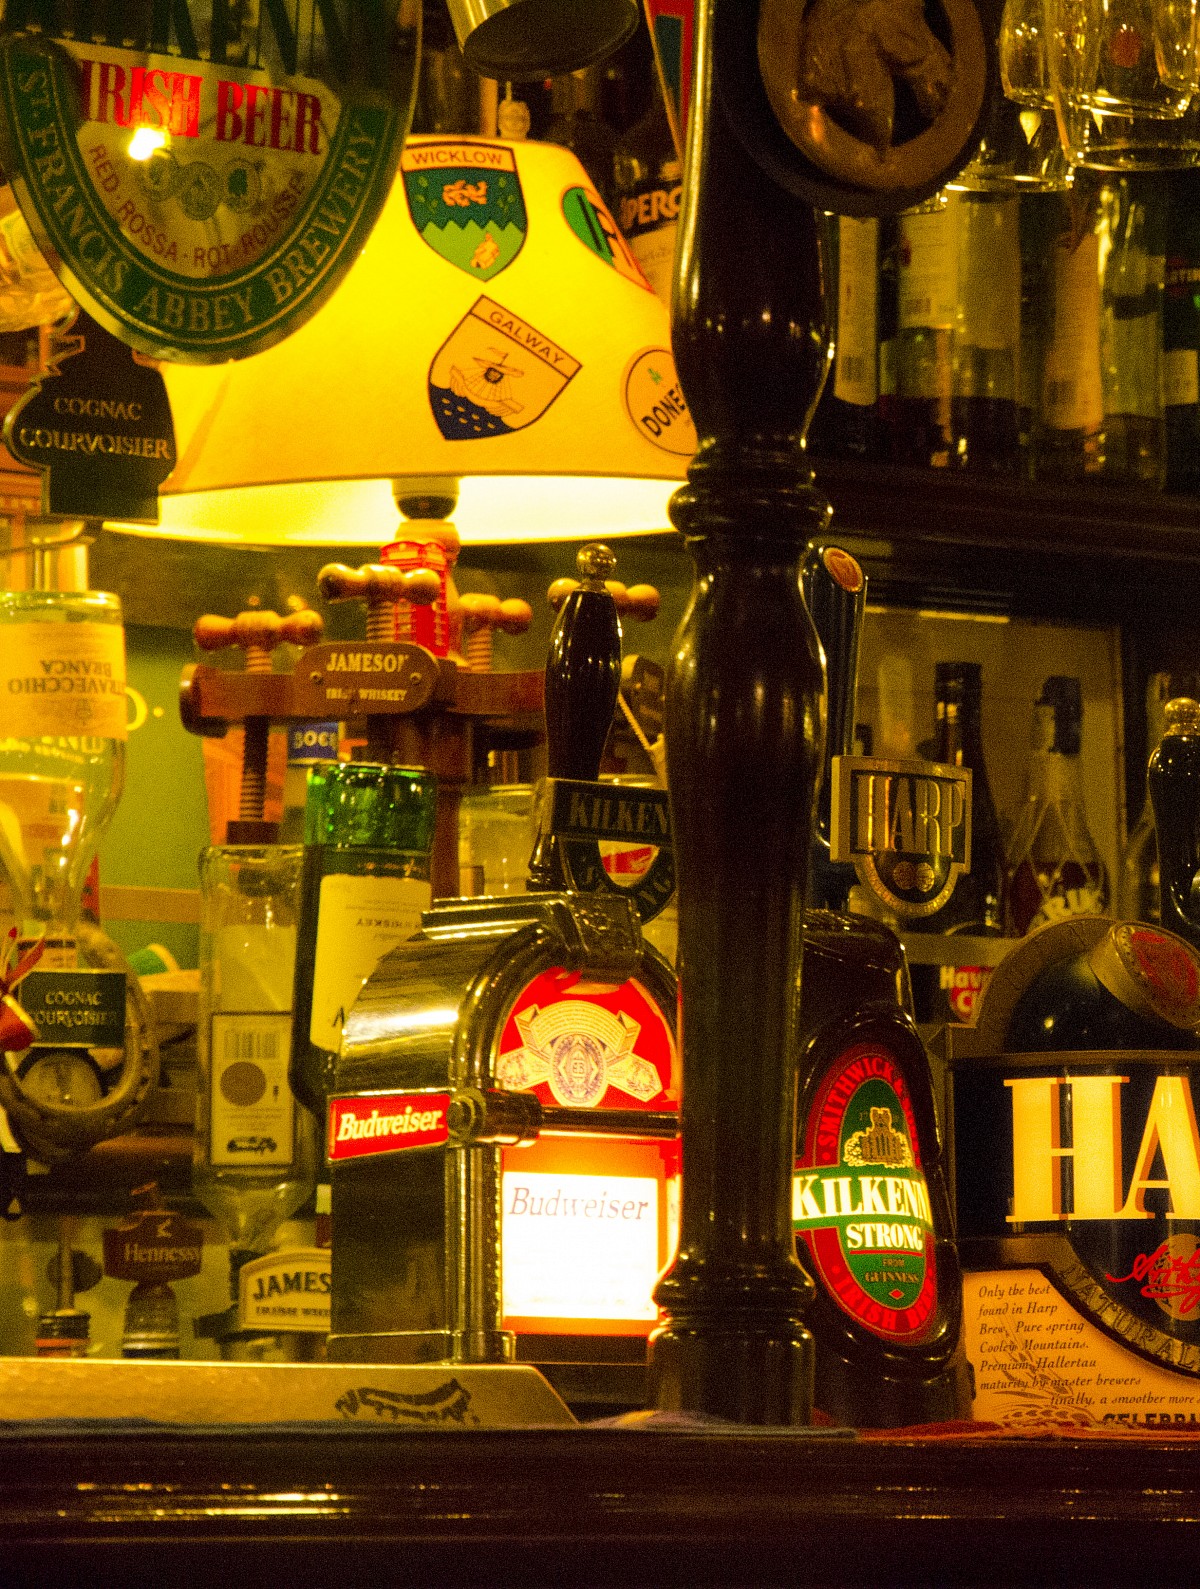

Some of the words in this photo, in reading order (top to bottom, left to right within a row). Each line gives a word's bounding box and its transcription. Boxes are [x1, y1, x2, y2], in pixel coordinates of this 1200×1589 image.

[80, 59, 203, 139] IRISH
[215, 80, 322, 155] BEER
[412, 150, 503, 165] WICKLOW
[88, 143, 120, 195] RED
[117, 203, 180, 266] ROSSA
[194, 246, 232, 269] ROT
[27, 123, 131, 294] FRANCIS
[133, 285, 257, 333] ABBEY
[264, 121, 376, 304] BREWERY
[490, 310, 565, 364] GALWAY
[53, 397, 142, 421] COGNAC
[19, 428, 171, 460] COURVOISIER
[358, 688, 408, 701] WHISKEY
[856, 773, 963, 859] HARP
[336, 1106, 444, 1141] Budweiser
[507, 1187, 649, 1220] Budweiser
[845, 1223, 924, 1251] STRONG
[252, 1272, 331, 1301] JAMES
[865, 1271, 919, 1283] GUINNESS
[832, 1275, 897, 1331] IRISH
[978, 1285, 1005, 1300] Only
[1008, 1283, 1025, 1296] the
[1028, 1283, 1051, 1296] best
[977, 1302, 1009, 1320] found
[1012, 1302, 1023, 1315] in
[1026, 1301, 1058, 1317] Harp
[1015, 1320, 1042, 1334] Pure
[1045, 1320, 1085, 1335] spring
[1021, 1338, 1089, 1352] Mountains.
[1036, 1356, 1097, 1370] Hallertau
[1096, 1373, 1141, 1387] brewers
[1100, 1396, 1108, 1405] a
[1112, 1391, 1166, 1405] smoother
[1169, 1395, 1195, 1405] more
